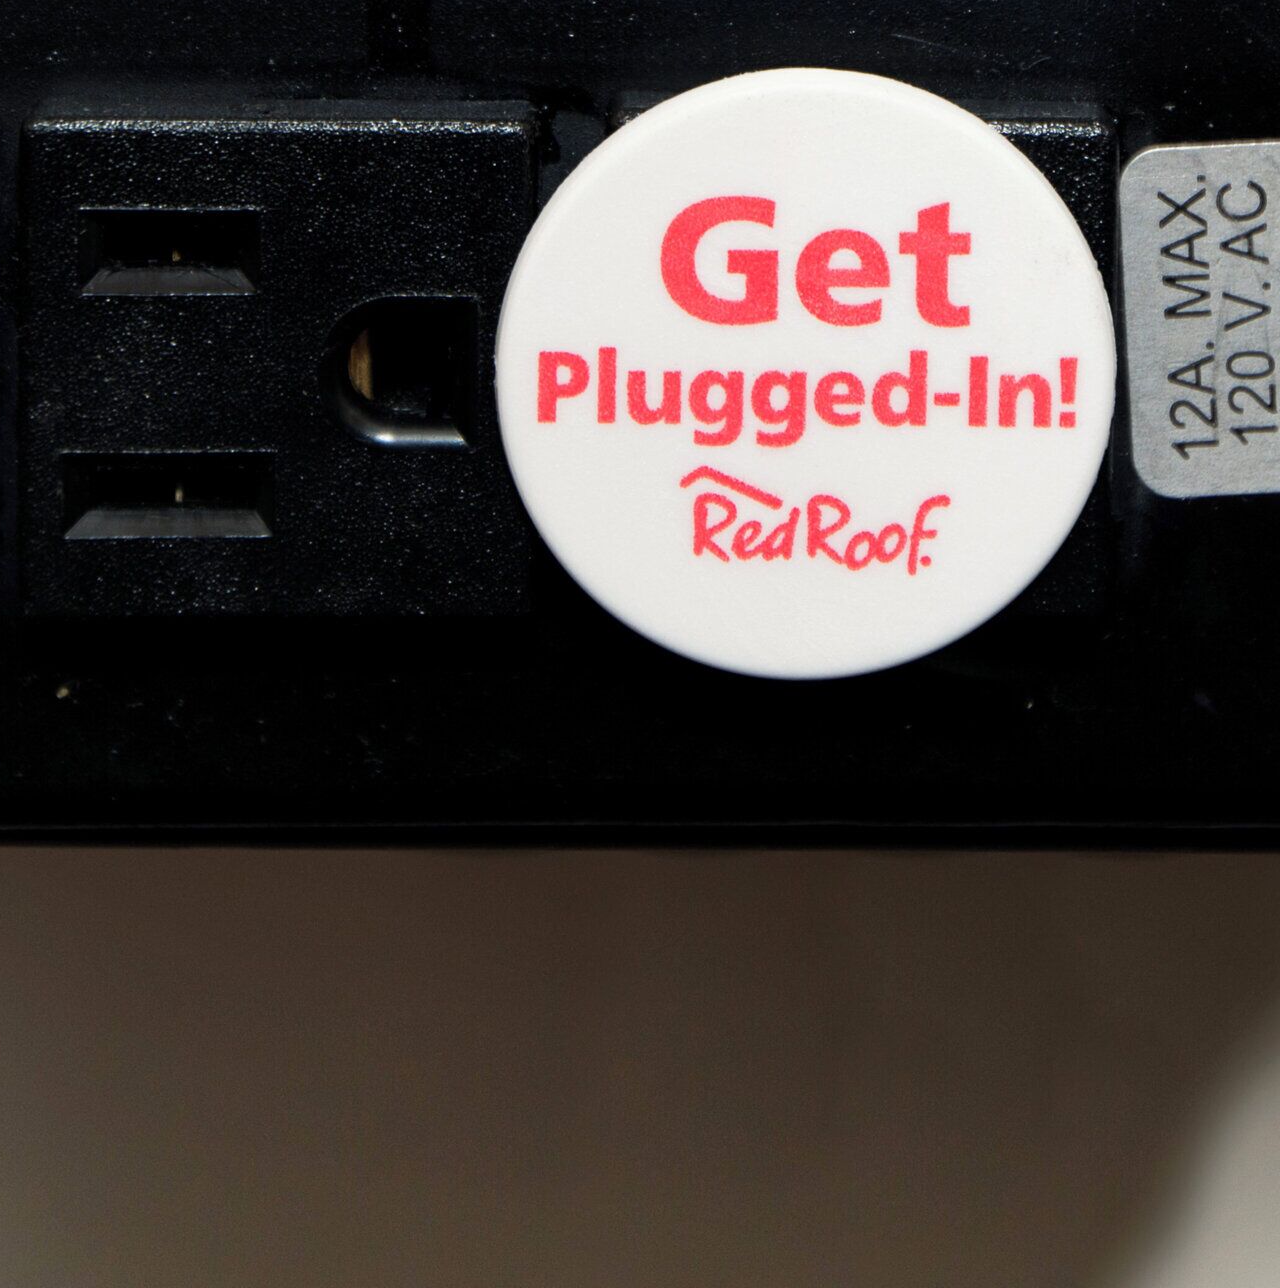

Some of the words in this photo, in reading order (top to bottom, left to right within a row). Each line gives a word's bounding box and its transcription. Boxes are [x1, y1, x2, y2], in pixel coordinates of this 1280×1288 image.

[659, 194, 972, 329] Get
[1156, 174, 1213, 320] MAX.
[535, 345, 1079, 449] Plugged-In!
[1167, 340, 1220, 460] 12A.
[1225, 350, 1278, 445] 120
